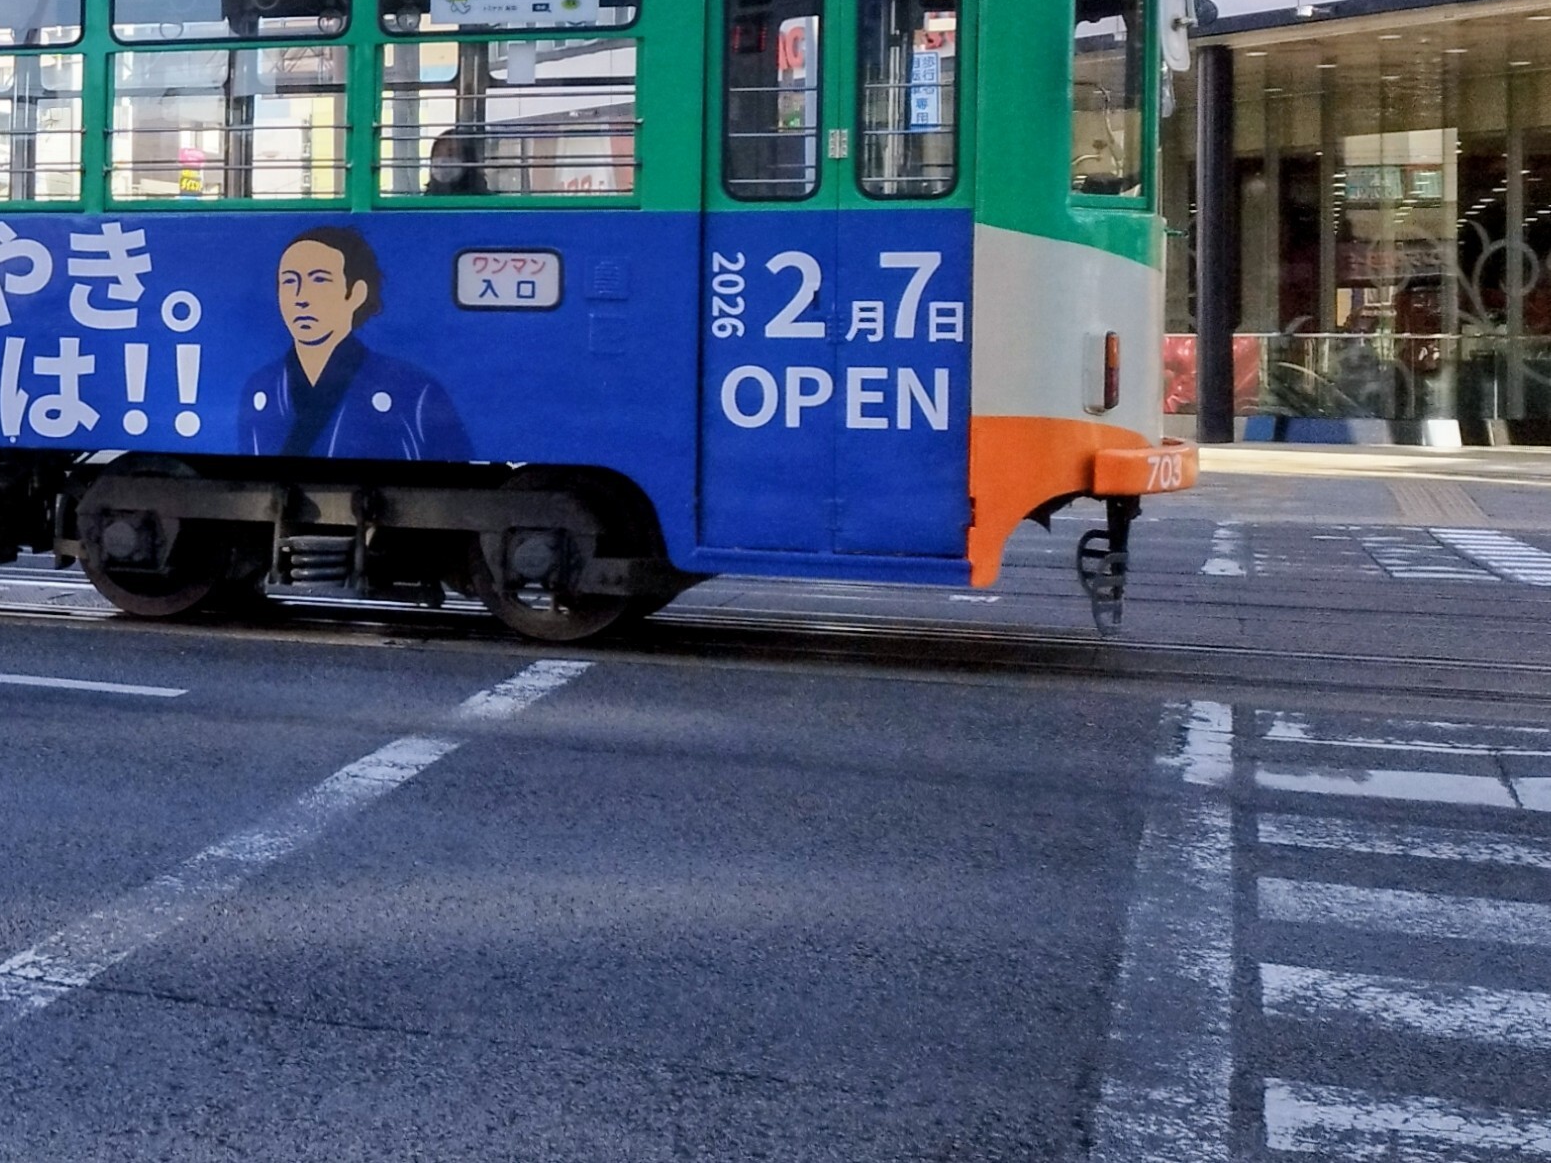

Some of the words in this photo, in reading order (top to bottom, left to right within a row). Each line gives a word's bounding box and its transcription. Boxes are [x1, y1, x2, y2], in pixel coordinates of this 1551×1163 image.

[473, 256, 546, 275] ワンマン
[479, 279, 536, 299] 入口
[712, 251, 745, 339] 2026
[720, 364, 950, 431] OPEN
[1146, 453, 1183, 491] 703
